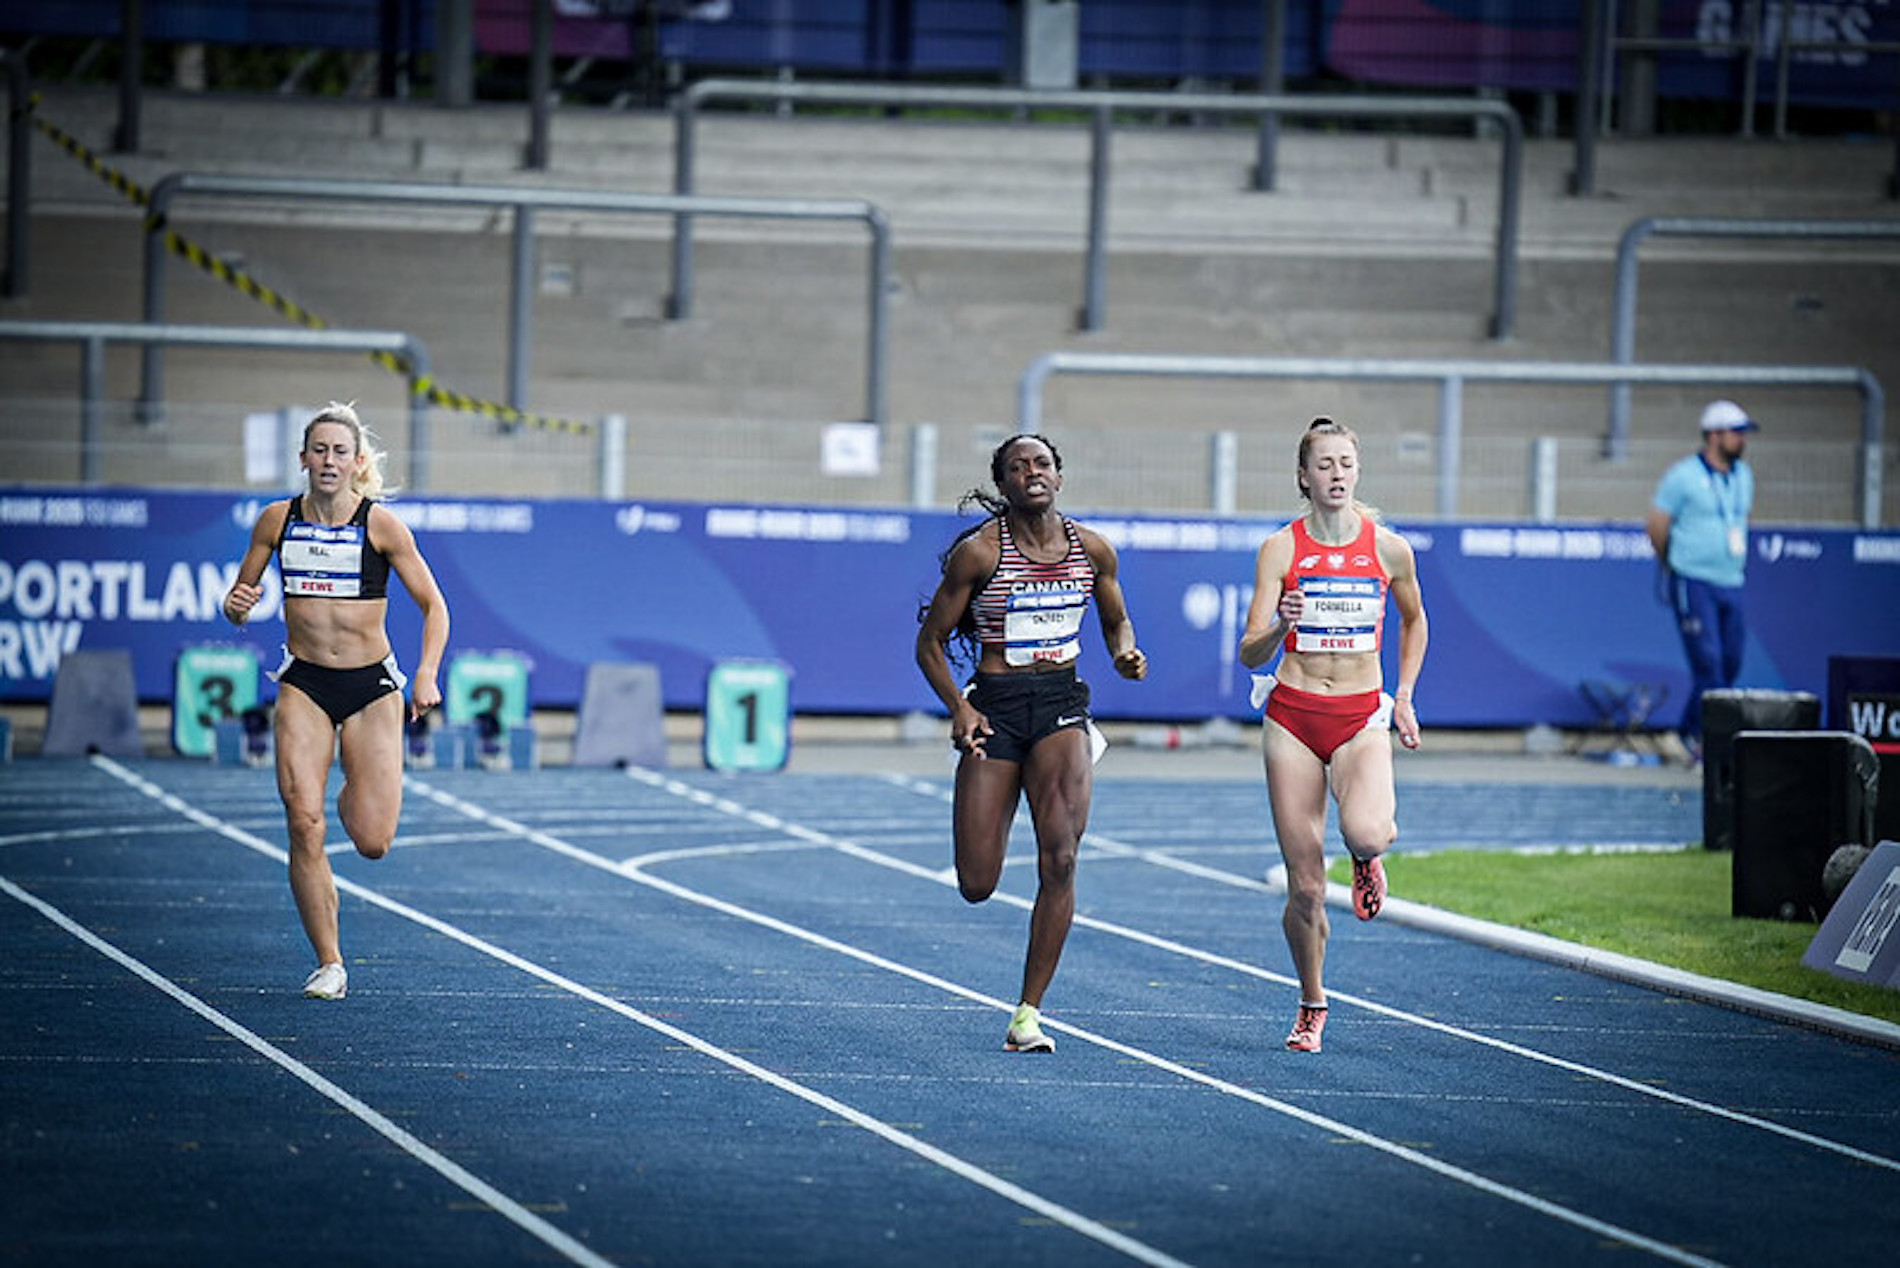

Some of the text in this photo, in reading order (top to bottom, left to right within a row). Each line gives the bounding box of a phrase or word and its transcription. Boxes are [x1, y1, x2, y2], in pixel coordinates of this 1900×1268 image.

[301, 582, 334, 592] REWE
[1315, 601, 1362, 612] FORMELLA
[1320, 638, 1355, 649] REWE
[199, 676, 234, 729] 3
[736, 692, 757, 744] 1
